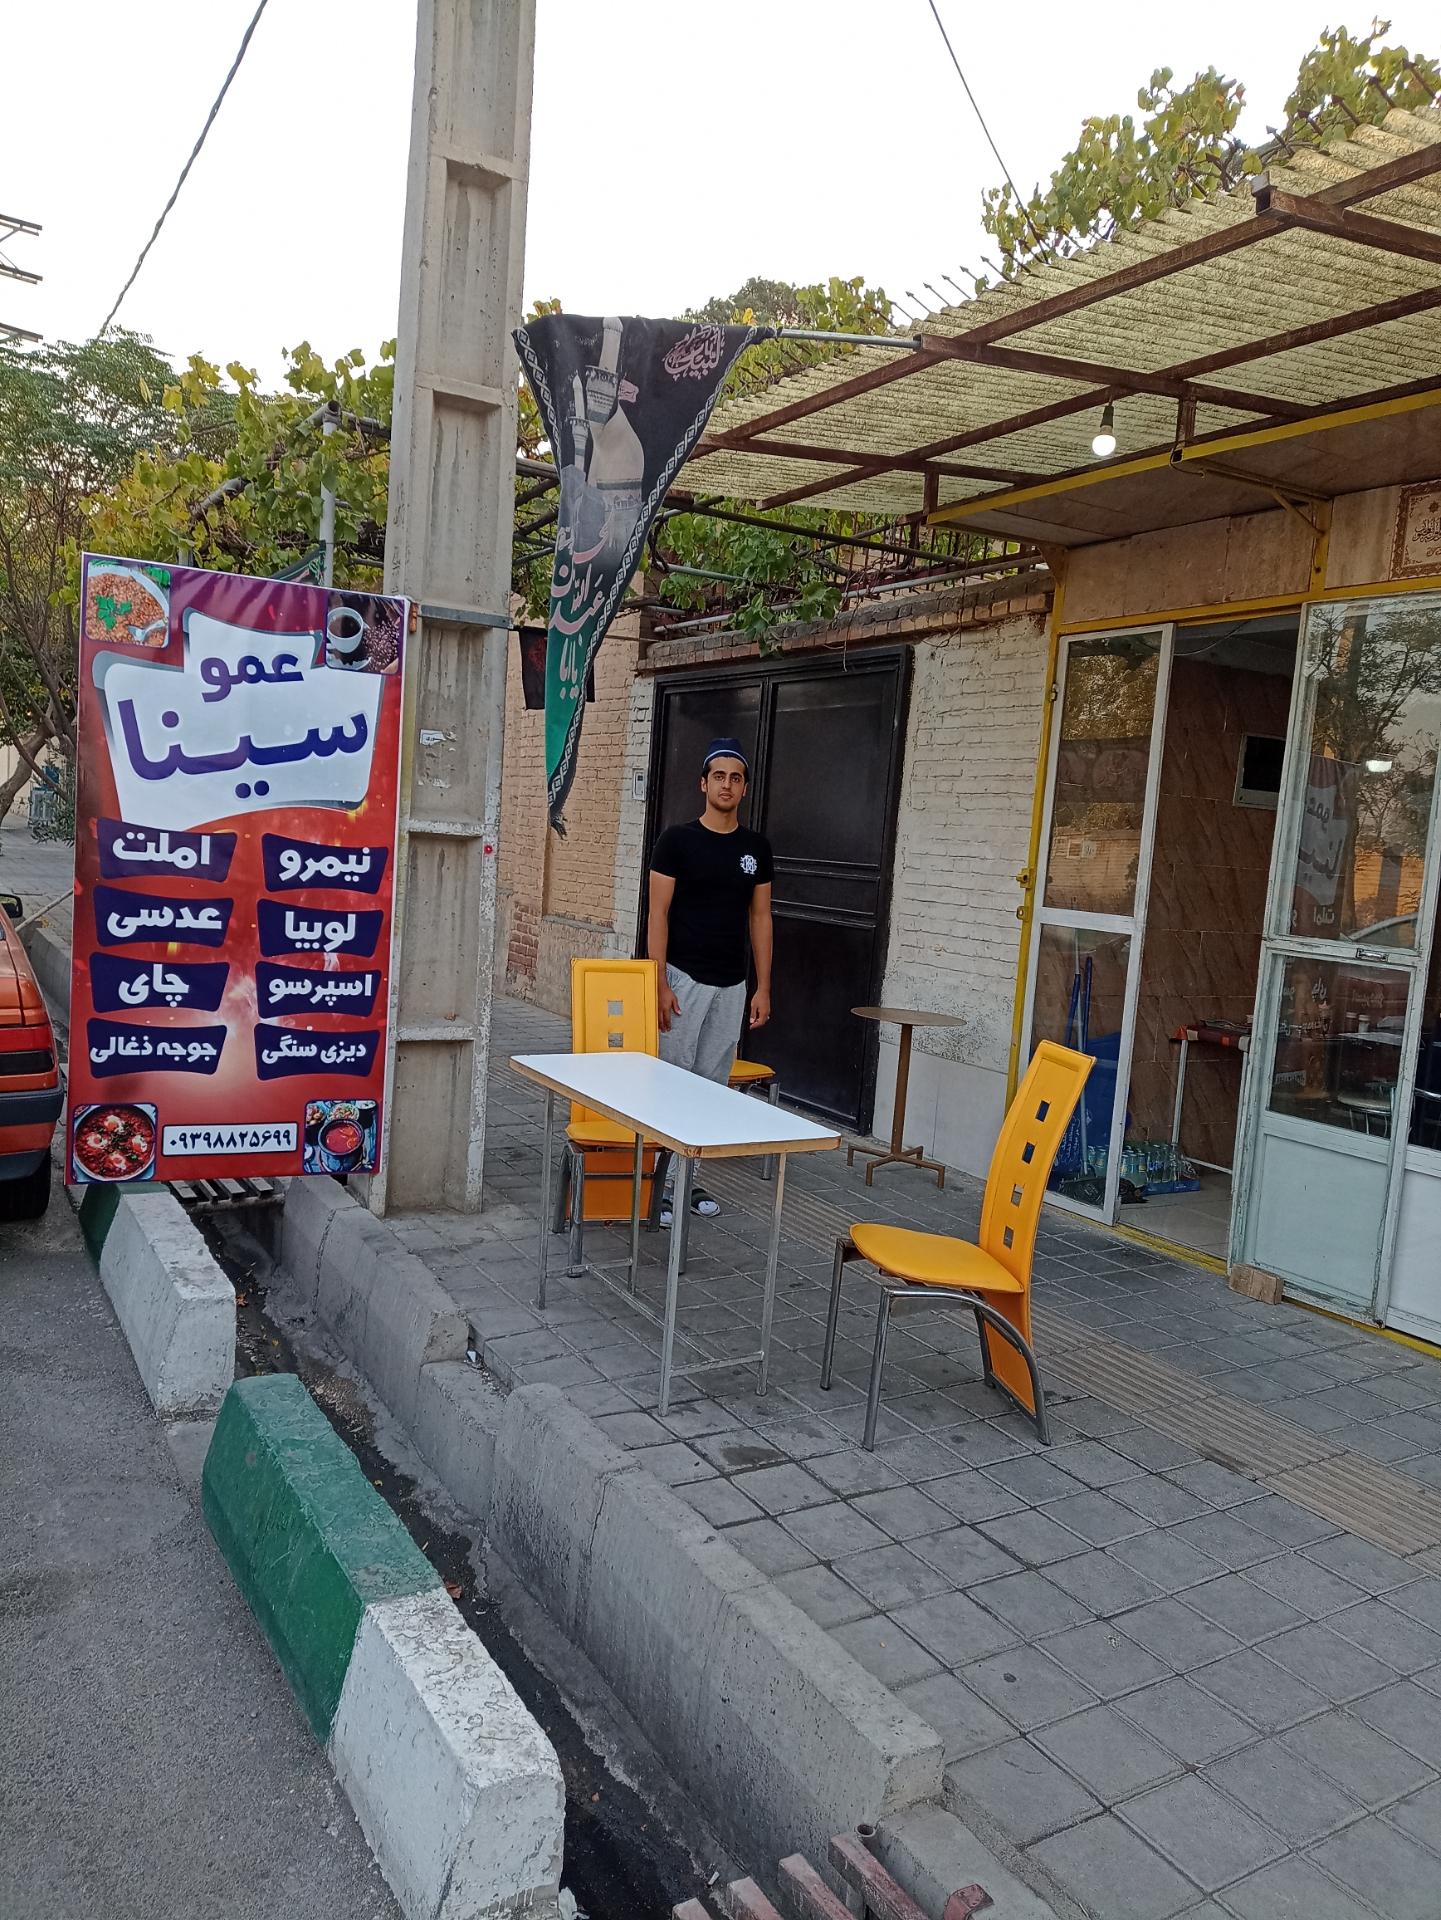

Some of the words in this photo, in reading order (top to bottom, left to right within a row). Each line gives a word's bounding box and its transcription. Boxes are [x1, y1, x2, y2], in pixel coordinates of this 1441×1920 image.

[200, 653, 304, 703] عمو
[117, 698, 368, 799] سینا
[112, 831, 211, 869] املت
[278, 846, 371, 882] نیمرو
[106, 904, 223, 938] عدسی
[285, 911, 356, 952] لوبیا
[118, 963, 190, 1008] چای
[268, 973, 372, 1006] اسپرسو
[90, 1036, 153, 1063] ذغالی
[157, 1038, 217, 1062] جوجه
[261, 1036, 318, 1064] سنگی
[320, 1042, 367, 1064] دیزی
[169, 1128, 292, 1150] ۰۹۳۹۸۸۲۵۶۹۹
